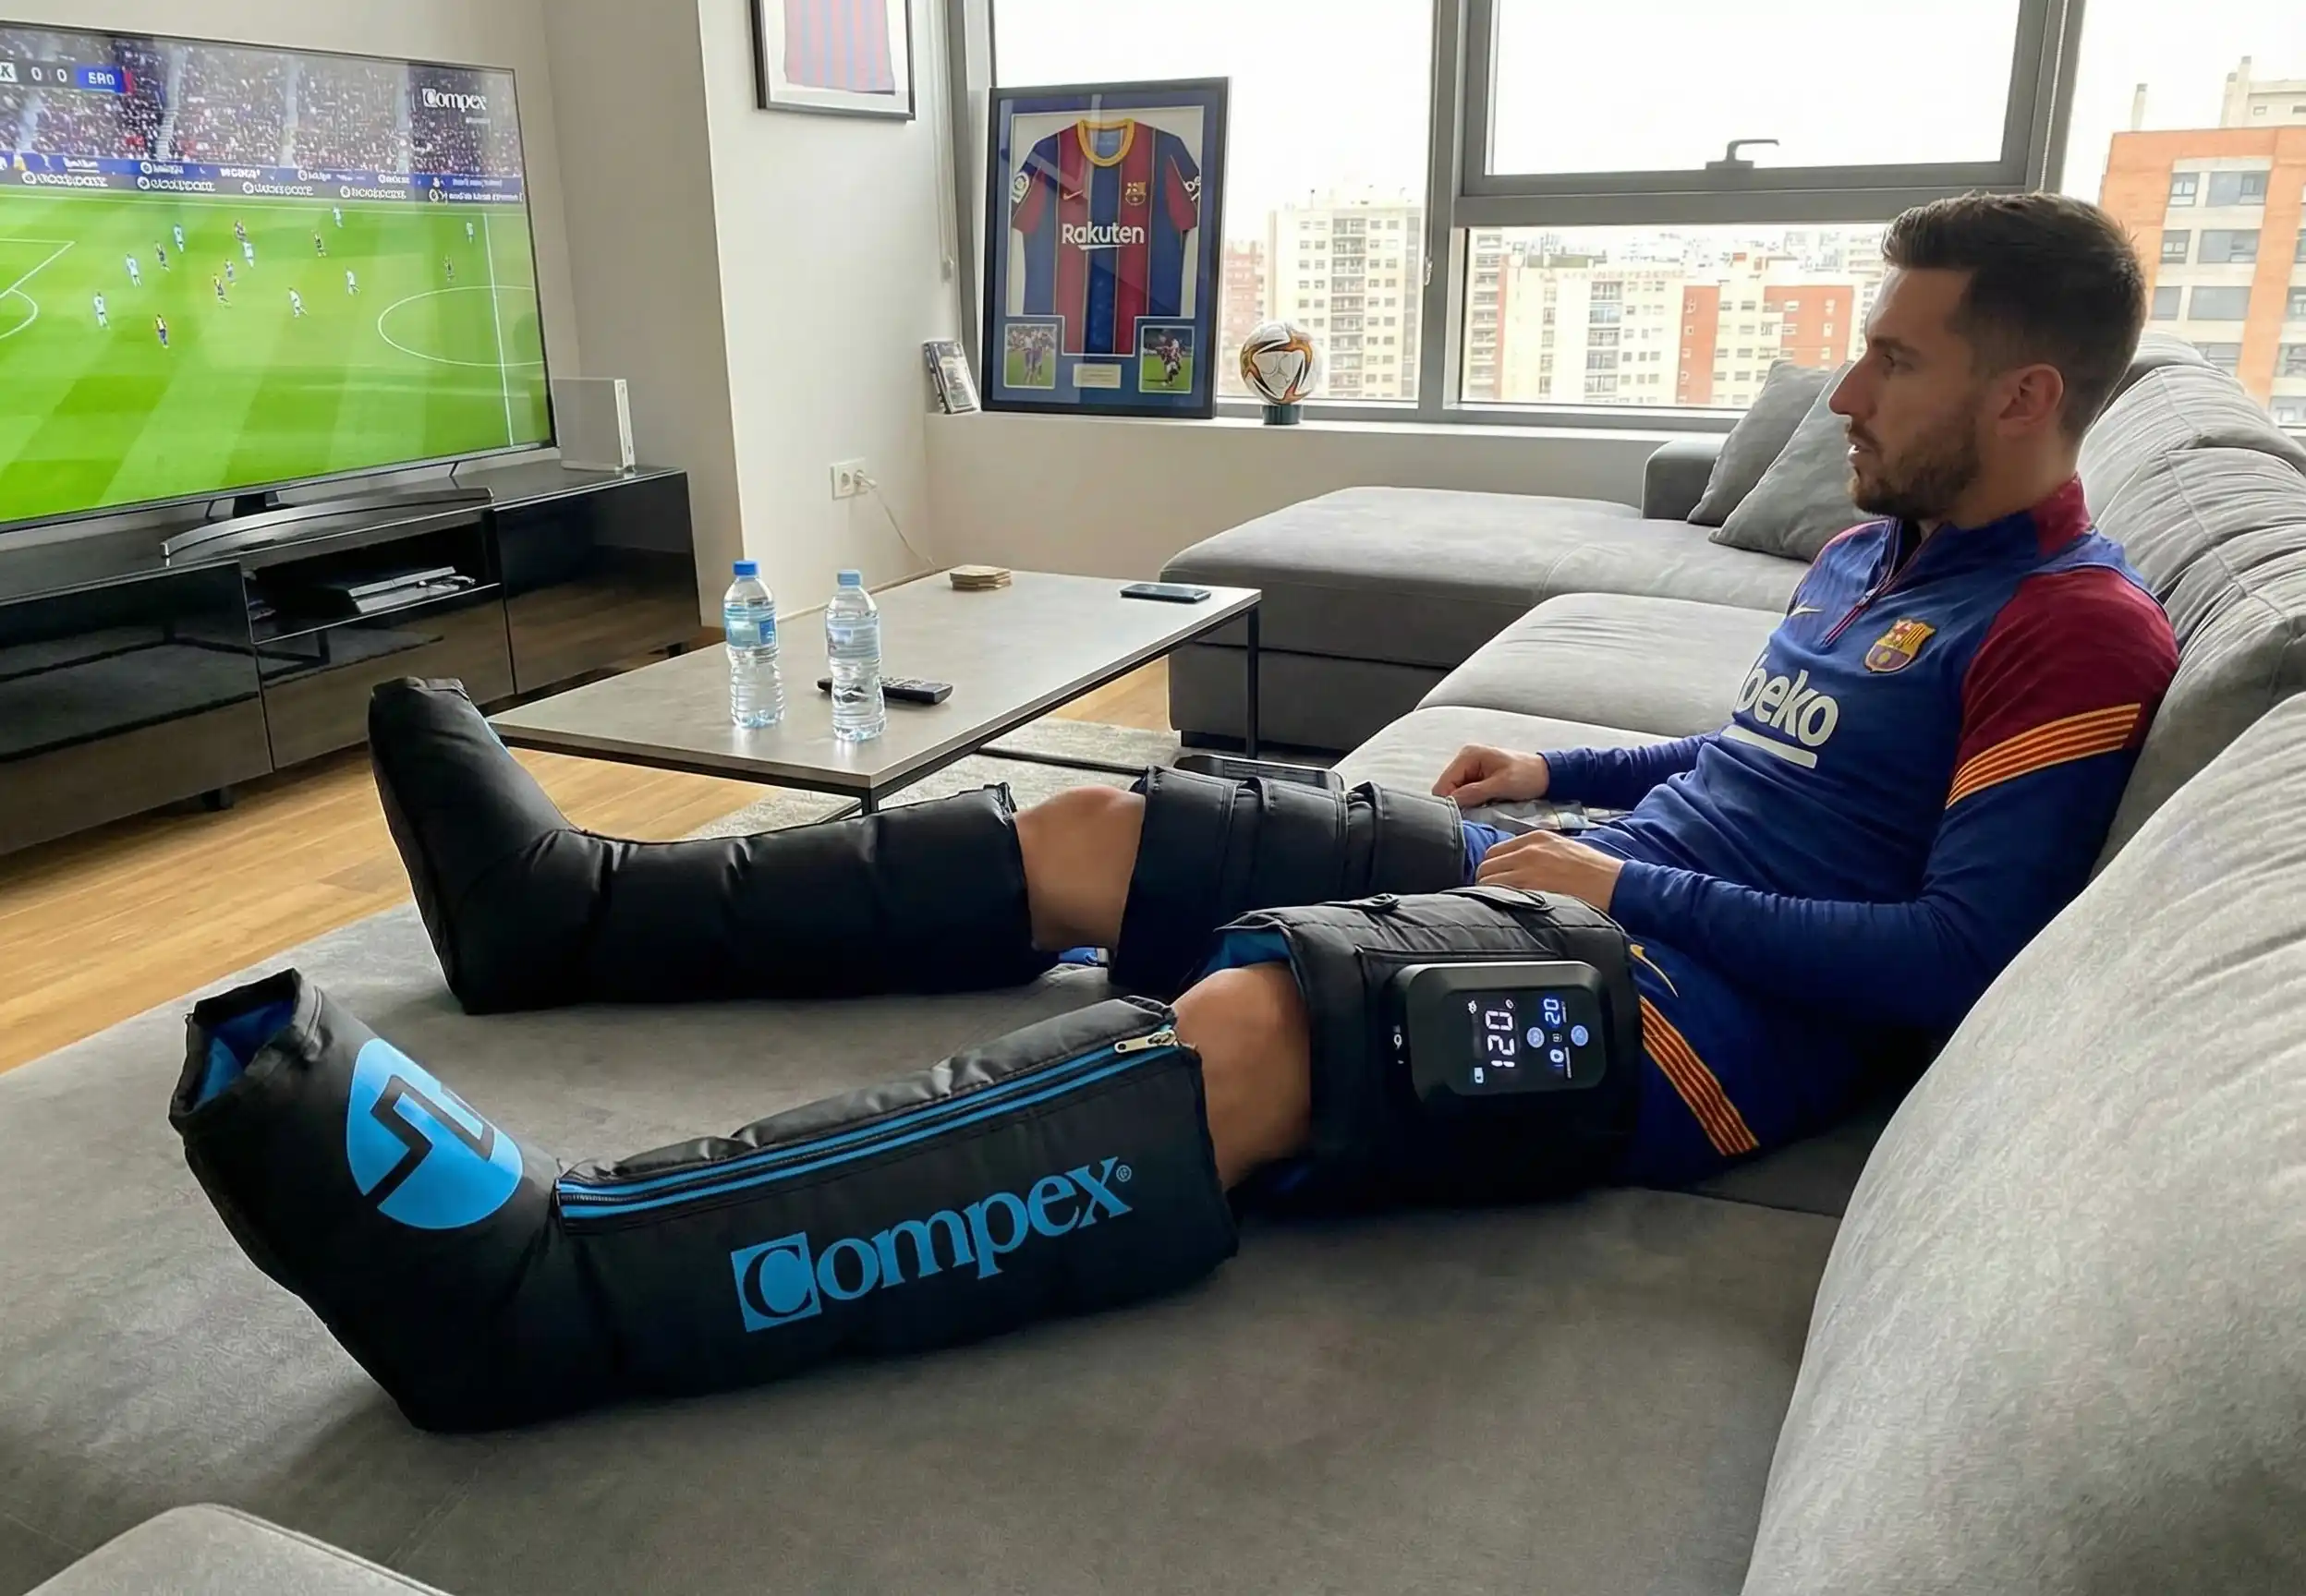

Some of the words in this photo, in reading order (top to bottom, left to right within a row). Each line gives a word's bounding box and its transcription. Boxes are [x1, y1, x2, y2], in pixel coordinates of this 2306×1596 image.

[30, 66, 42, 81] 0
[56, 68, 67, 82] 0
[421, 88, 488, 113] Compex
[1062, 222, 1145, 244] Rakuten
[1735, 652, 1839, 747] beko
